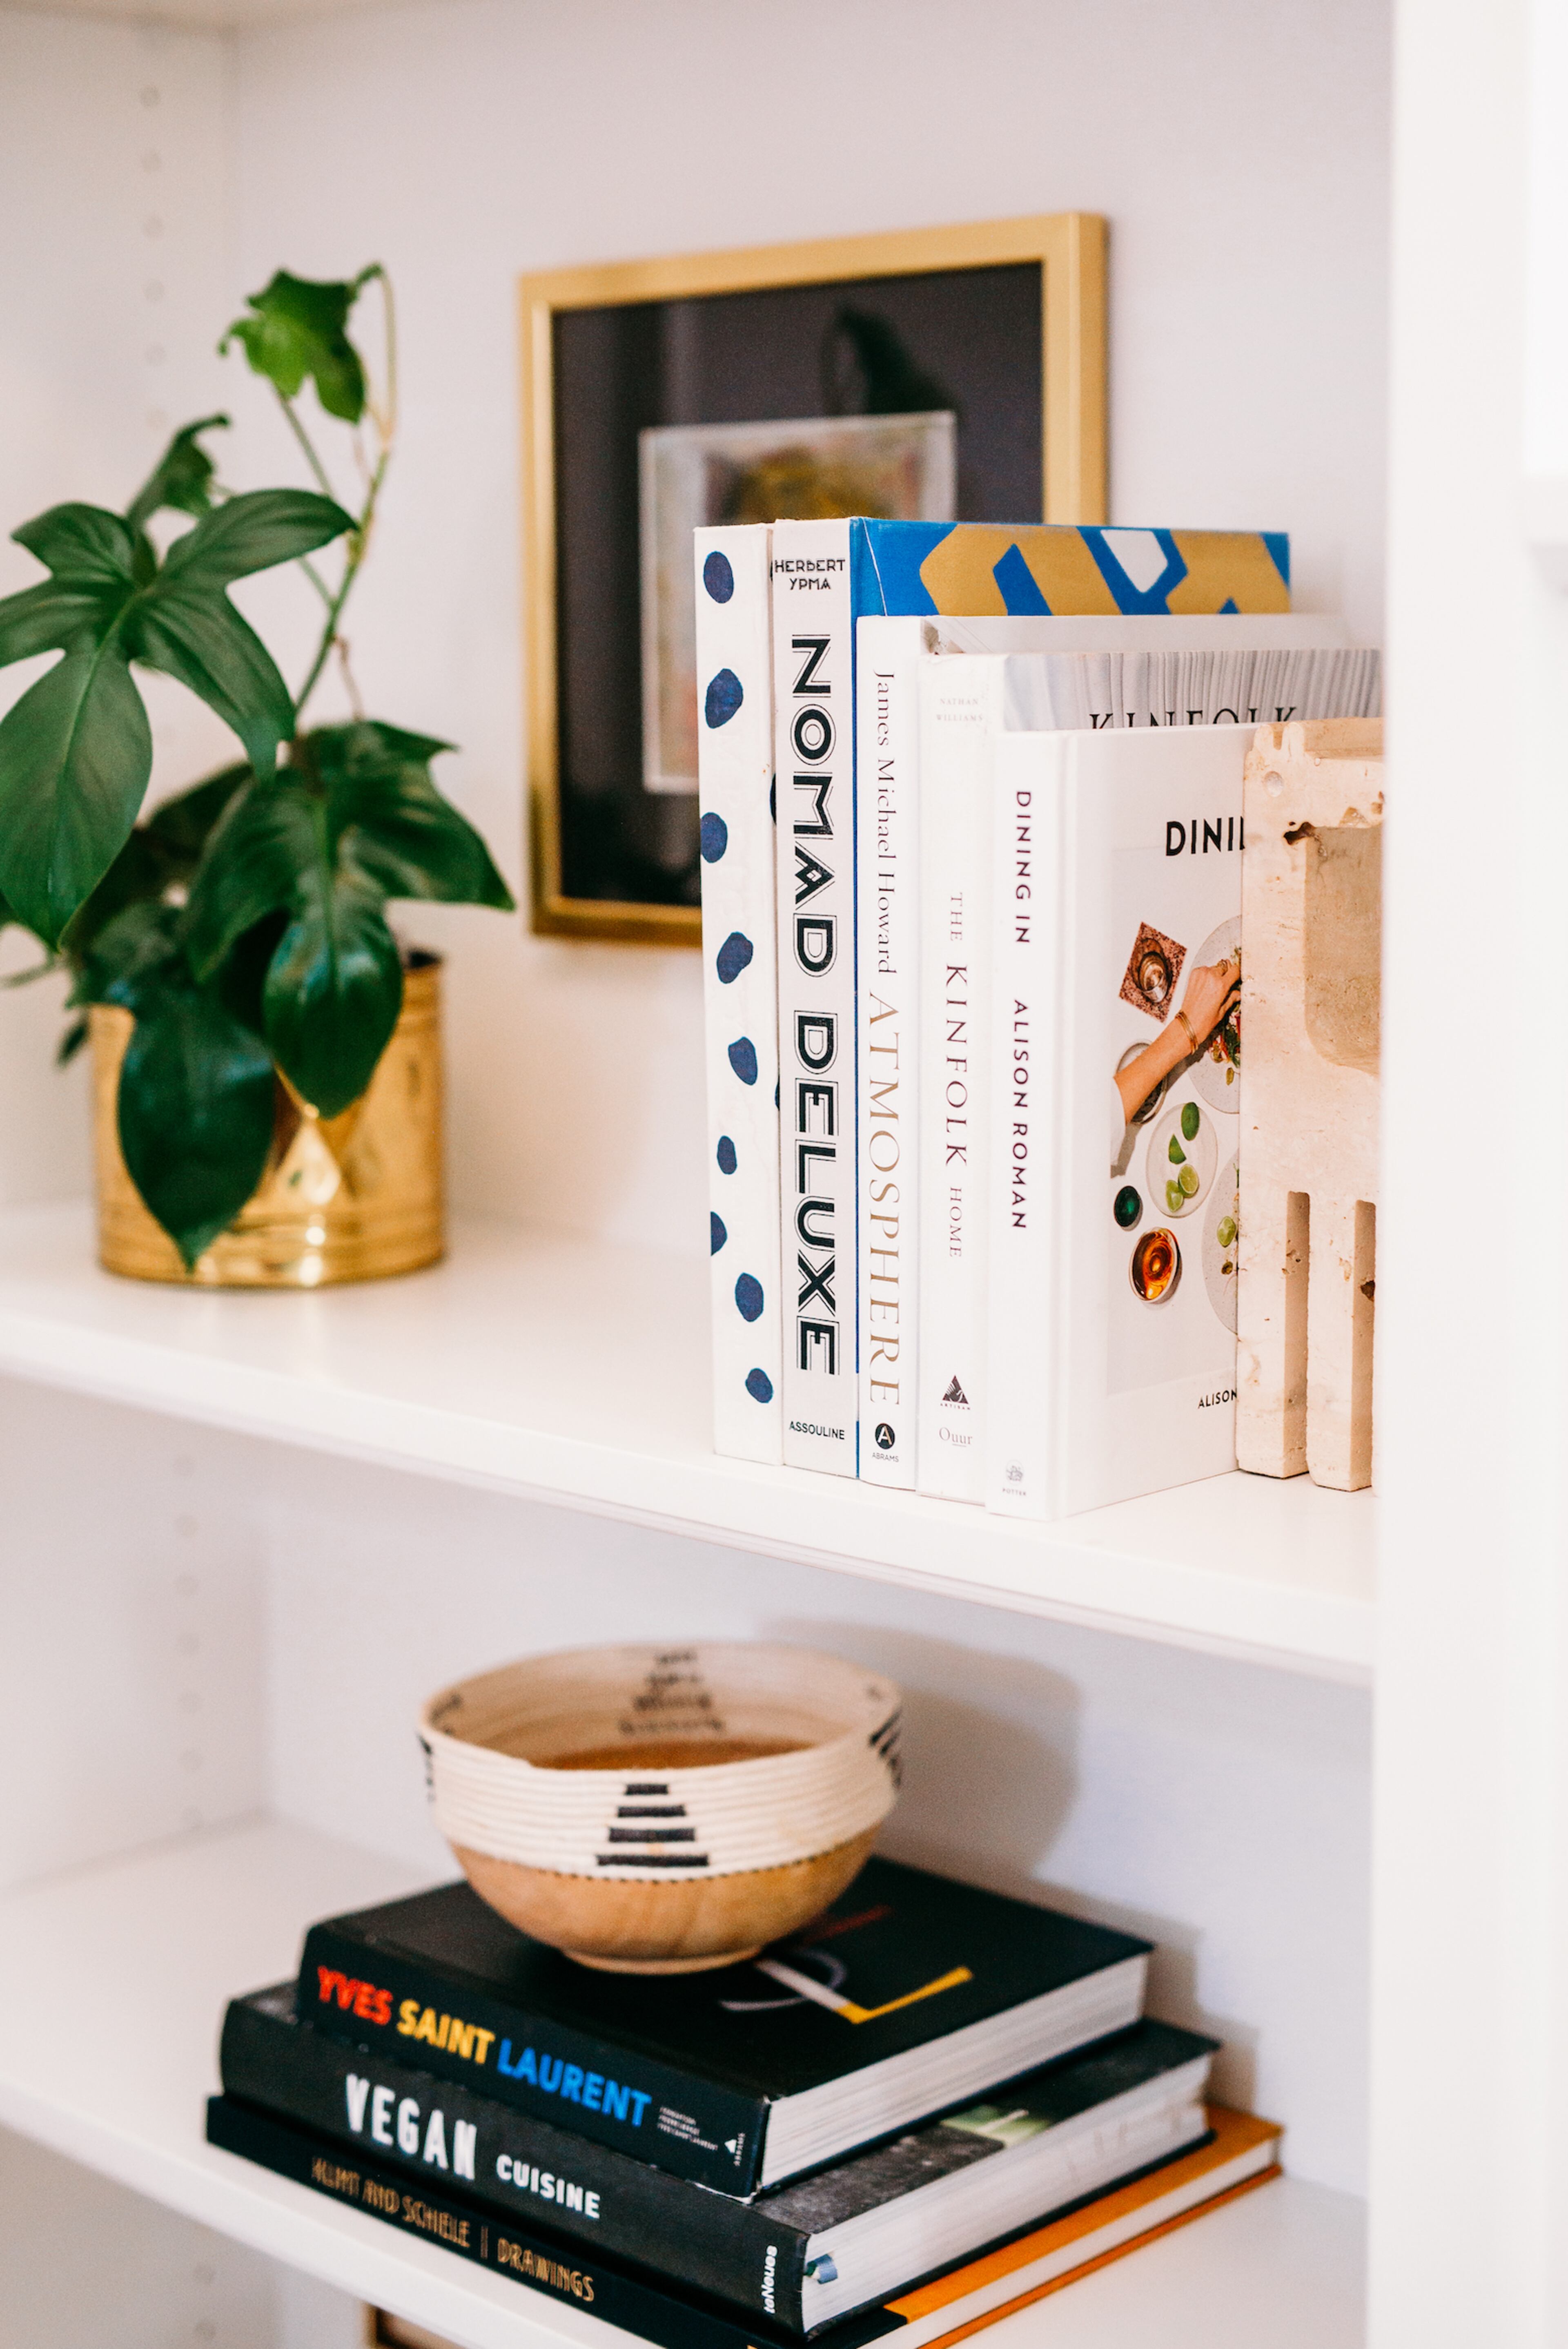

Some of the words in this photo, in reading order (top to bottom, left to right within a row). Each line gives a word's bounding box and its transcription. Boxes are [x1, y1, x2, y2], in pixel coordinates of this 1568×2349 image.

[775, 559, 846, 573] HERBERT
[789, 578, 831, 591] YPMA
[873, 669, 895, 746] James
[790, 634, 837, 977] NOMAD
[878, 758, 896, 860] Michael
[1015, 791, 1032, 900] DINING
[1165, 816, 1245, 857] DINI
[878, 872, 897, 974] Howard
[950, 892, 963, 941] THE
[1015, 915, 1031, 943] IN
[945, 964, 967, 1167] KINFOLK
[1013, 999, 1029, 1108] ALISON
[793, 1010, 840, 1376] DELUXE
[869, 991, 900, 1405] ATMOSPHERE
[949, 1187, 962, 1258] HOME
[1012, 1122, 1028, 1229] ROMAN
[789, 1421, 845, 1440] ASSOULINE
[872, 1452, 899, 1463] ABRAMS
[939, 1427, 973, 1445] Ouur
[317, 1966, 394, 2026] YVES
[396, 1999, 496, 2064] SAINT
[497, 2038, 653, 2127] LAURENT
[345, 2073, 478, 2180] VEGAN
[495, 2154, 601, 2219] CUISINE
[362, 2179, 400, 2214] AND
[497, 2237, 595, 2302] DRAWINGS
